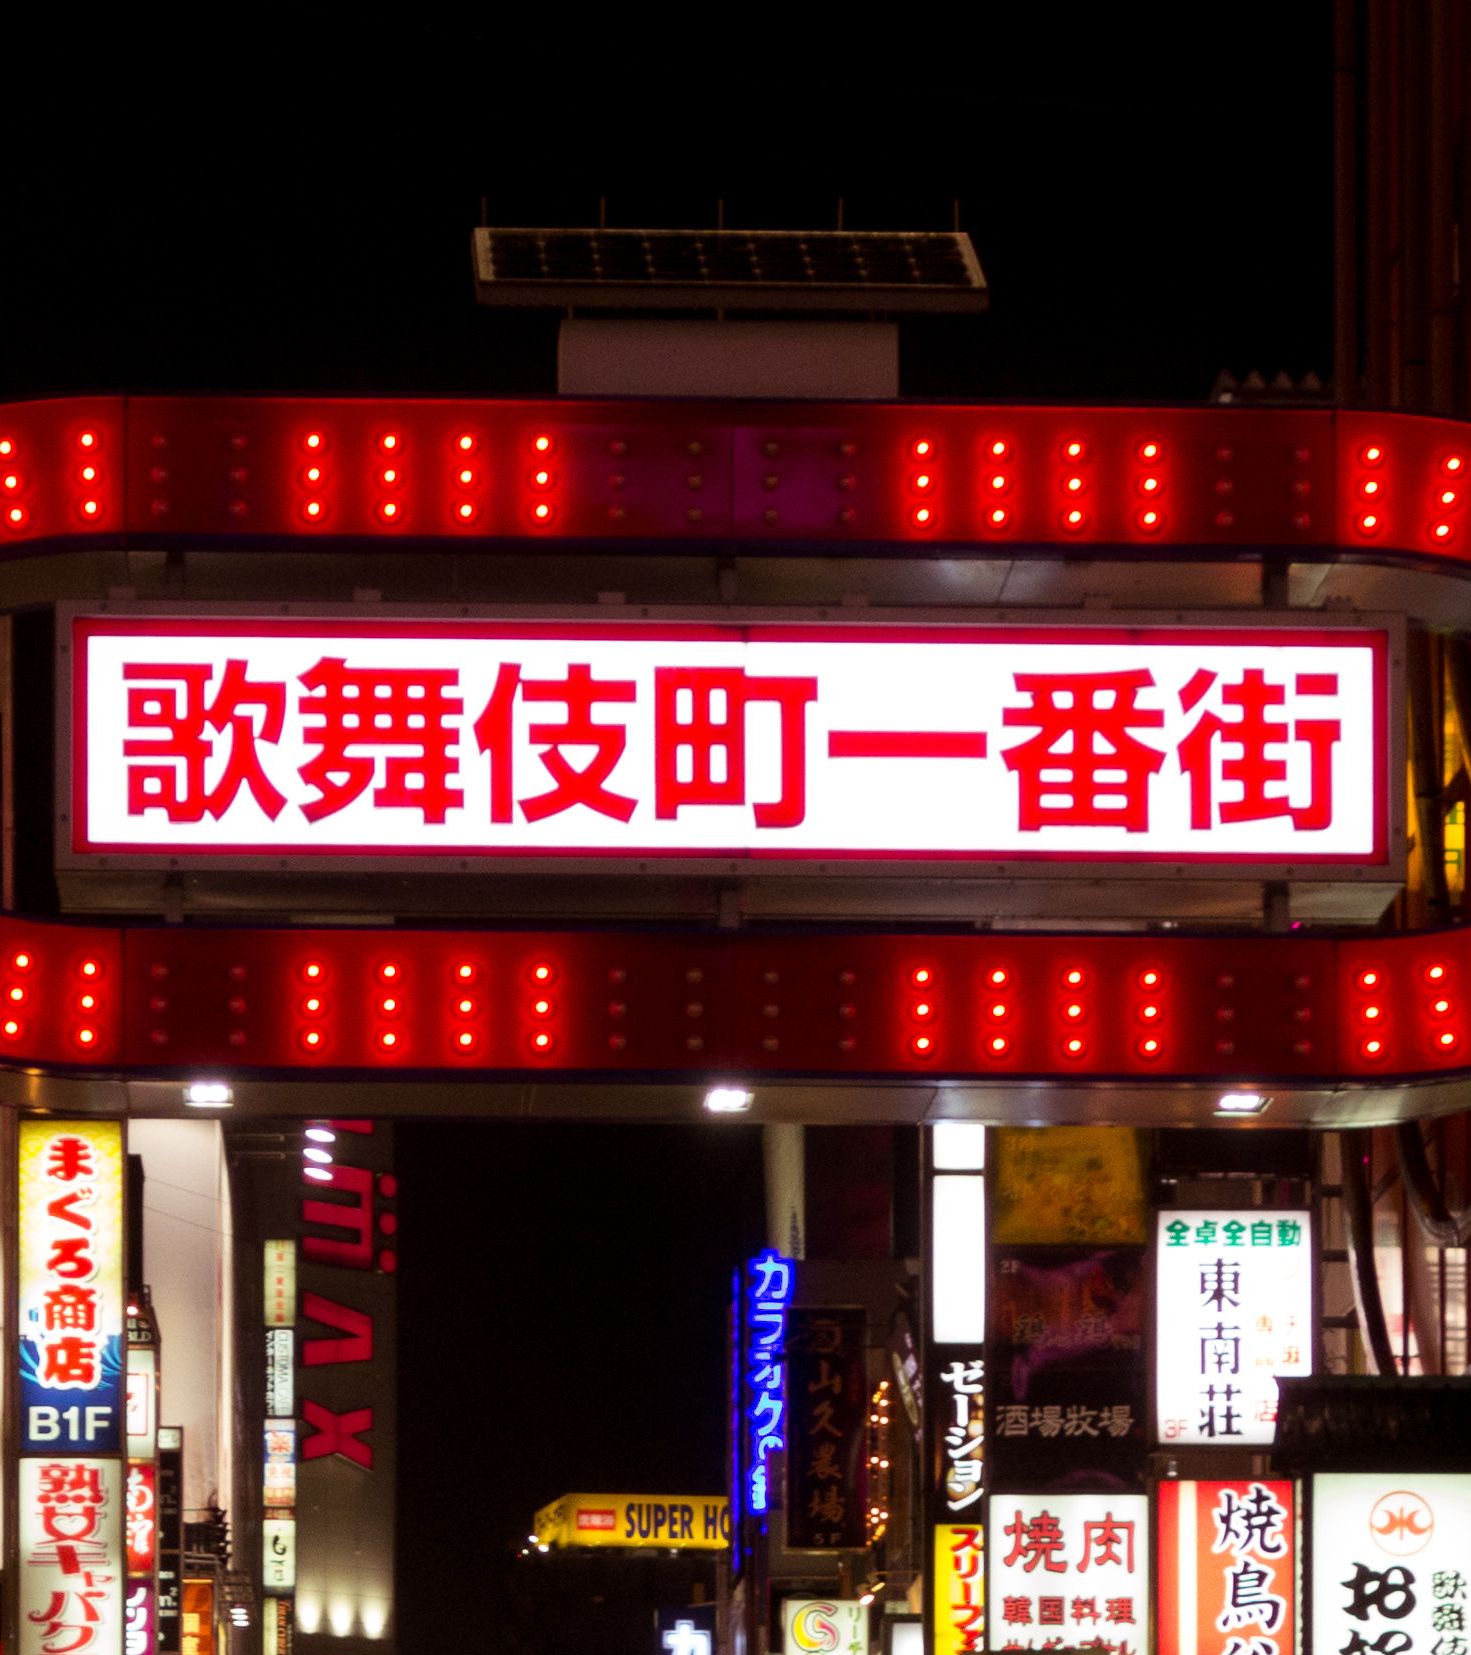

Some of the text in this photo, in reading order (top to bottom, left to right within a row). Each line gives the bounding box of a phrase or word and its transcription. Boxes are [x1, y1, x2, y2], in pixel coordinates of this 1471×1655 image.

[121, 655, 1342, 835] 歌舞伎町一番街
[1164, 1218, 1303, 1248] 全卓全自動
[43, 1135, 99, 1389] まぐろ商店
[1197, 1258, 1244, 1438] 東南荘
[28, 1406, 112, 1442] B1F
[995, 1404, 1134, 1438] 酒場牧場
[625, 1502, 693, 1540] SUPER
[1003, 1509, 1135, 1574] 焼肉
[1002, 1595, 1137, 1626] 韓国料理
